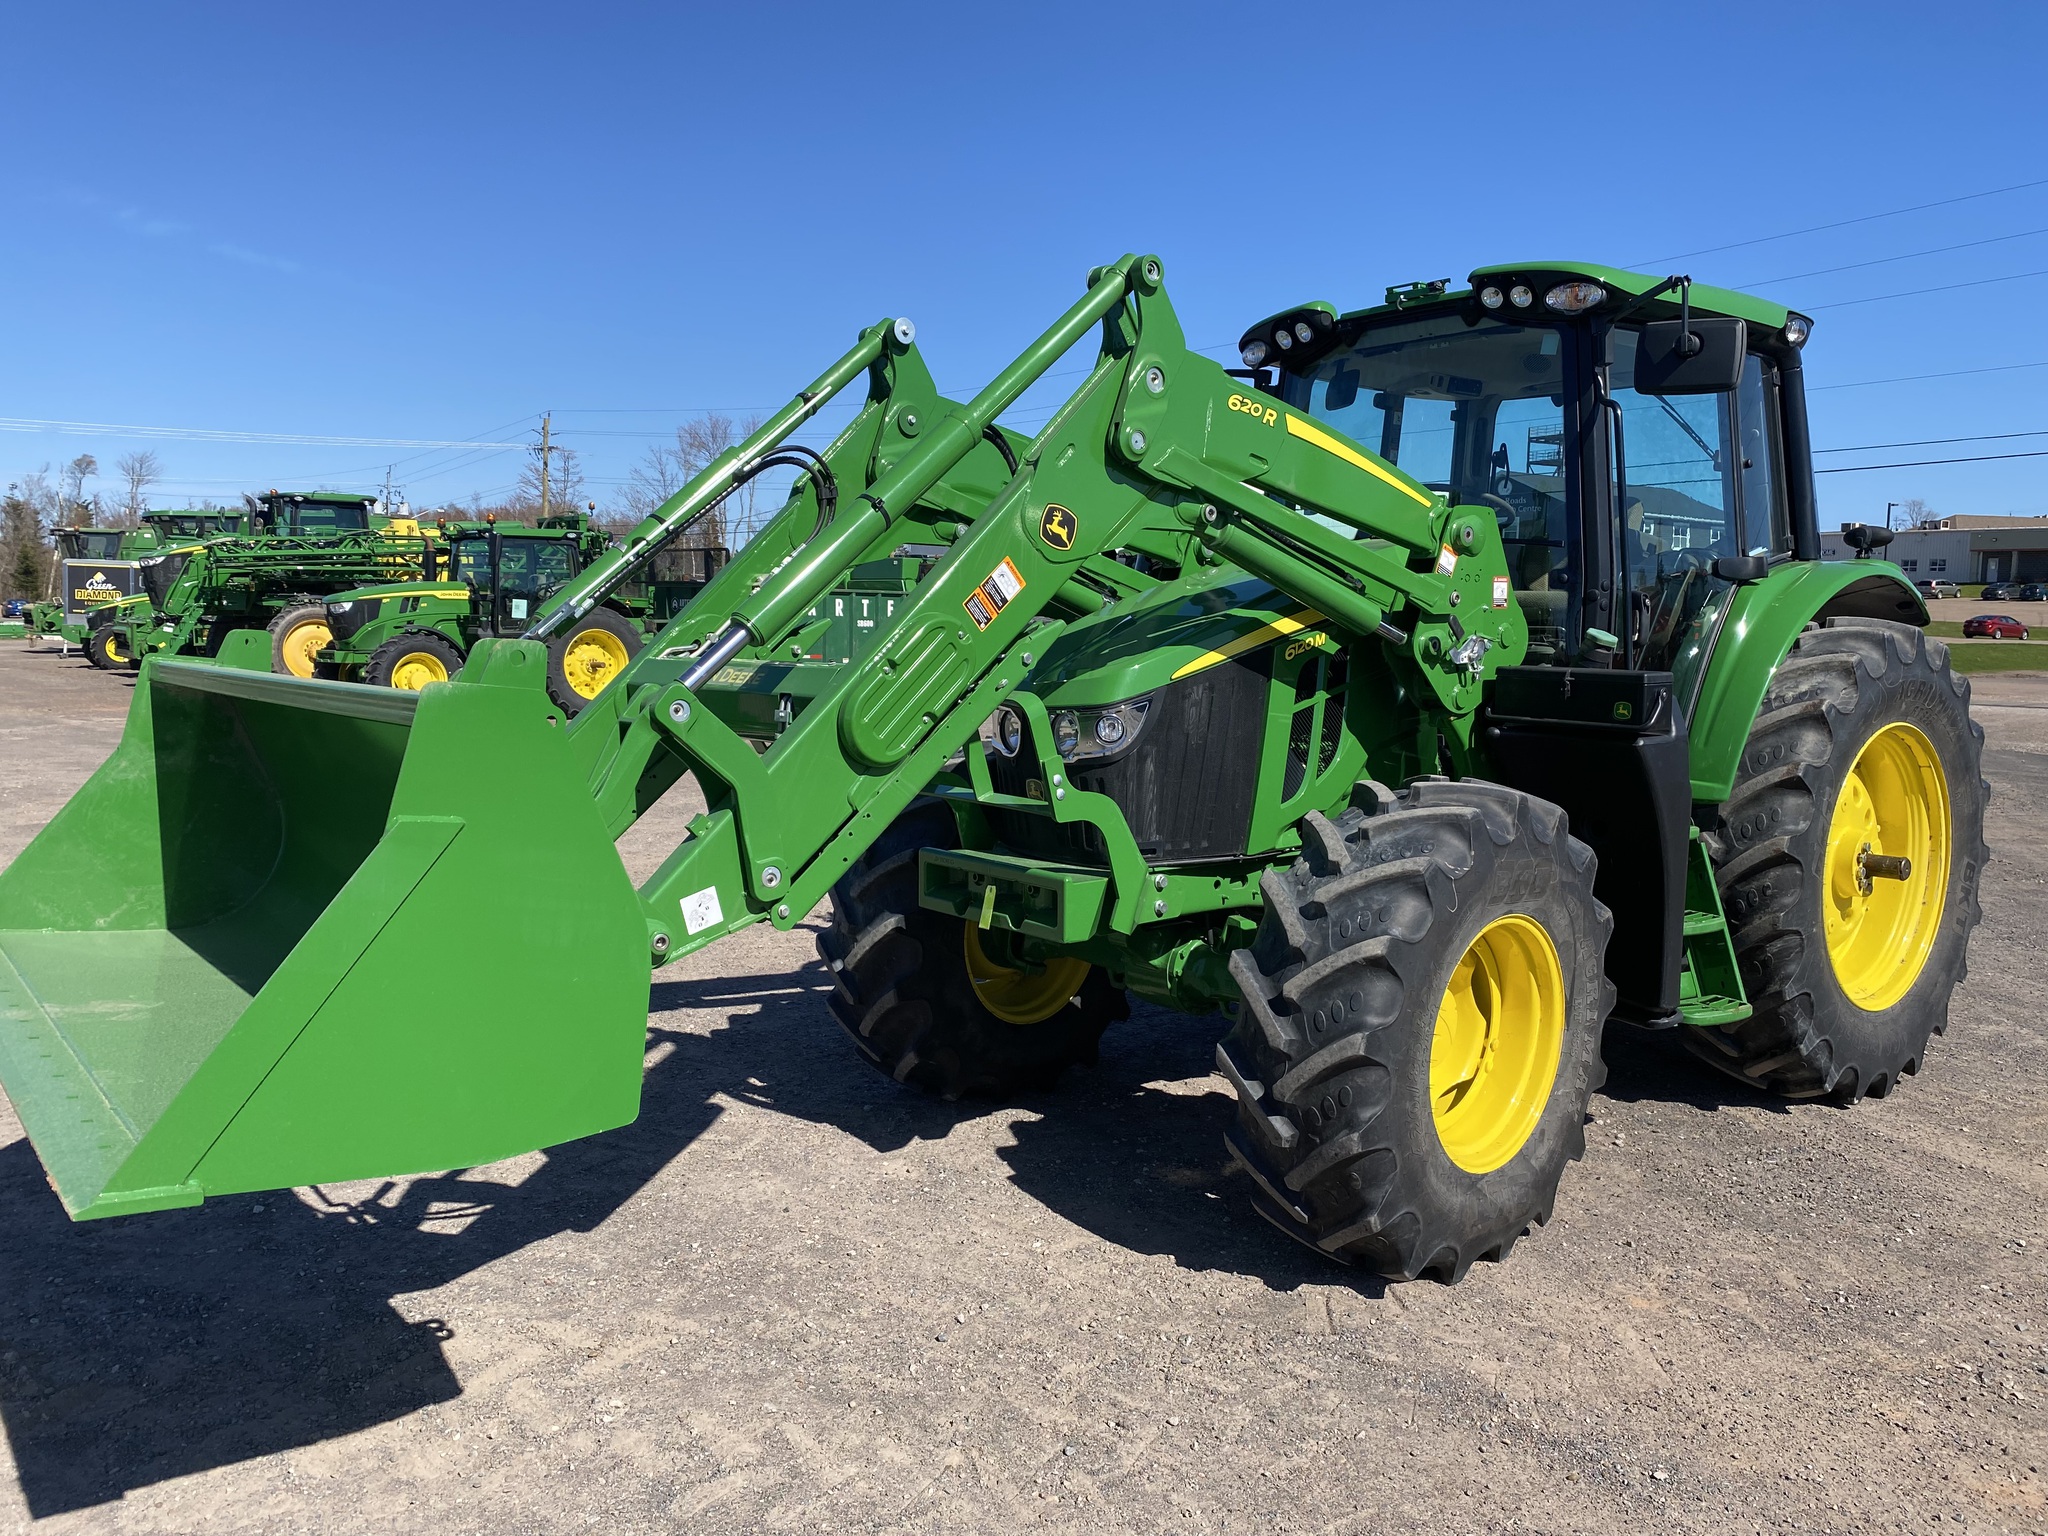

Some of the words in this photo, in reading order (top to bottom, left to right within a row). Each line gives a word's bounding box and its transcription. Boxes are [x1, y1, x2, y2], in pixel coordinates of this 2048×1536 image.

[1518, 505, 1542, 513] Centre
[86, 579, 117, 590] Green
[76, 589, 121, 600] DIAMOND
[1956, 861, 1977, 935] BKT
